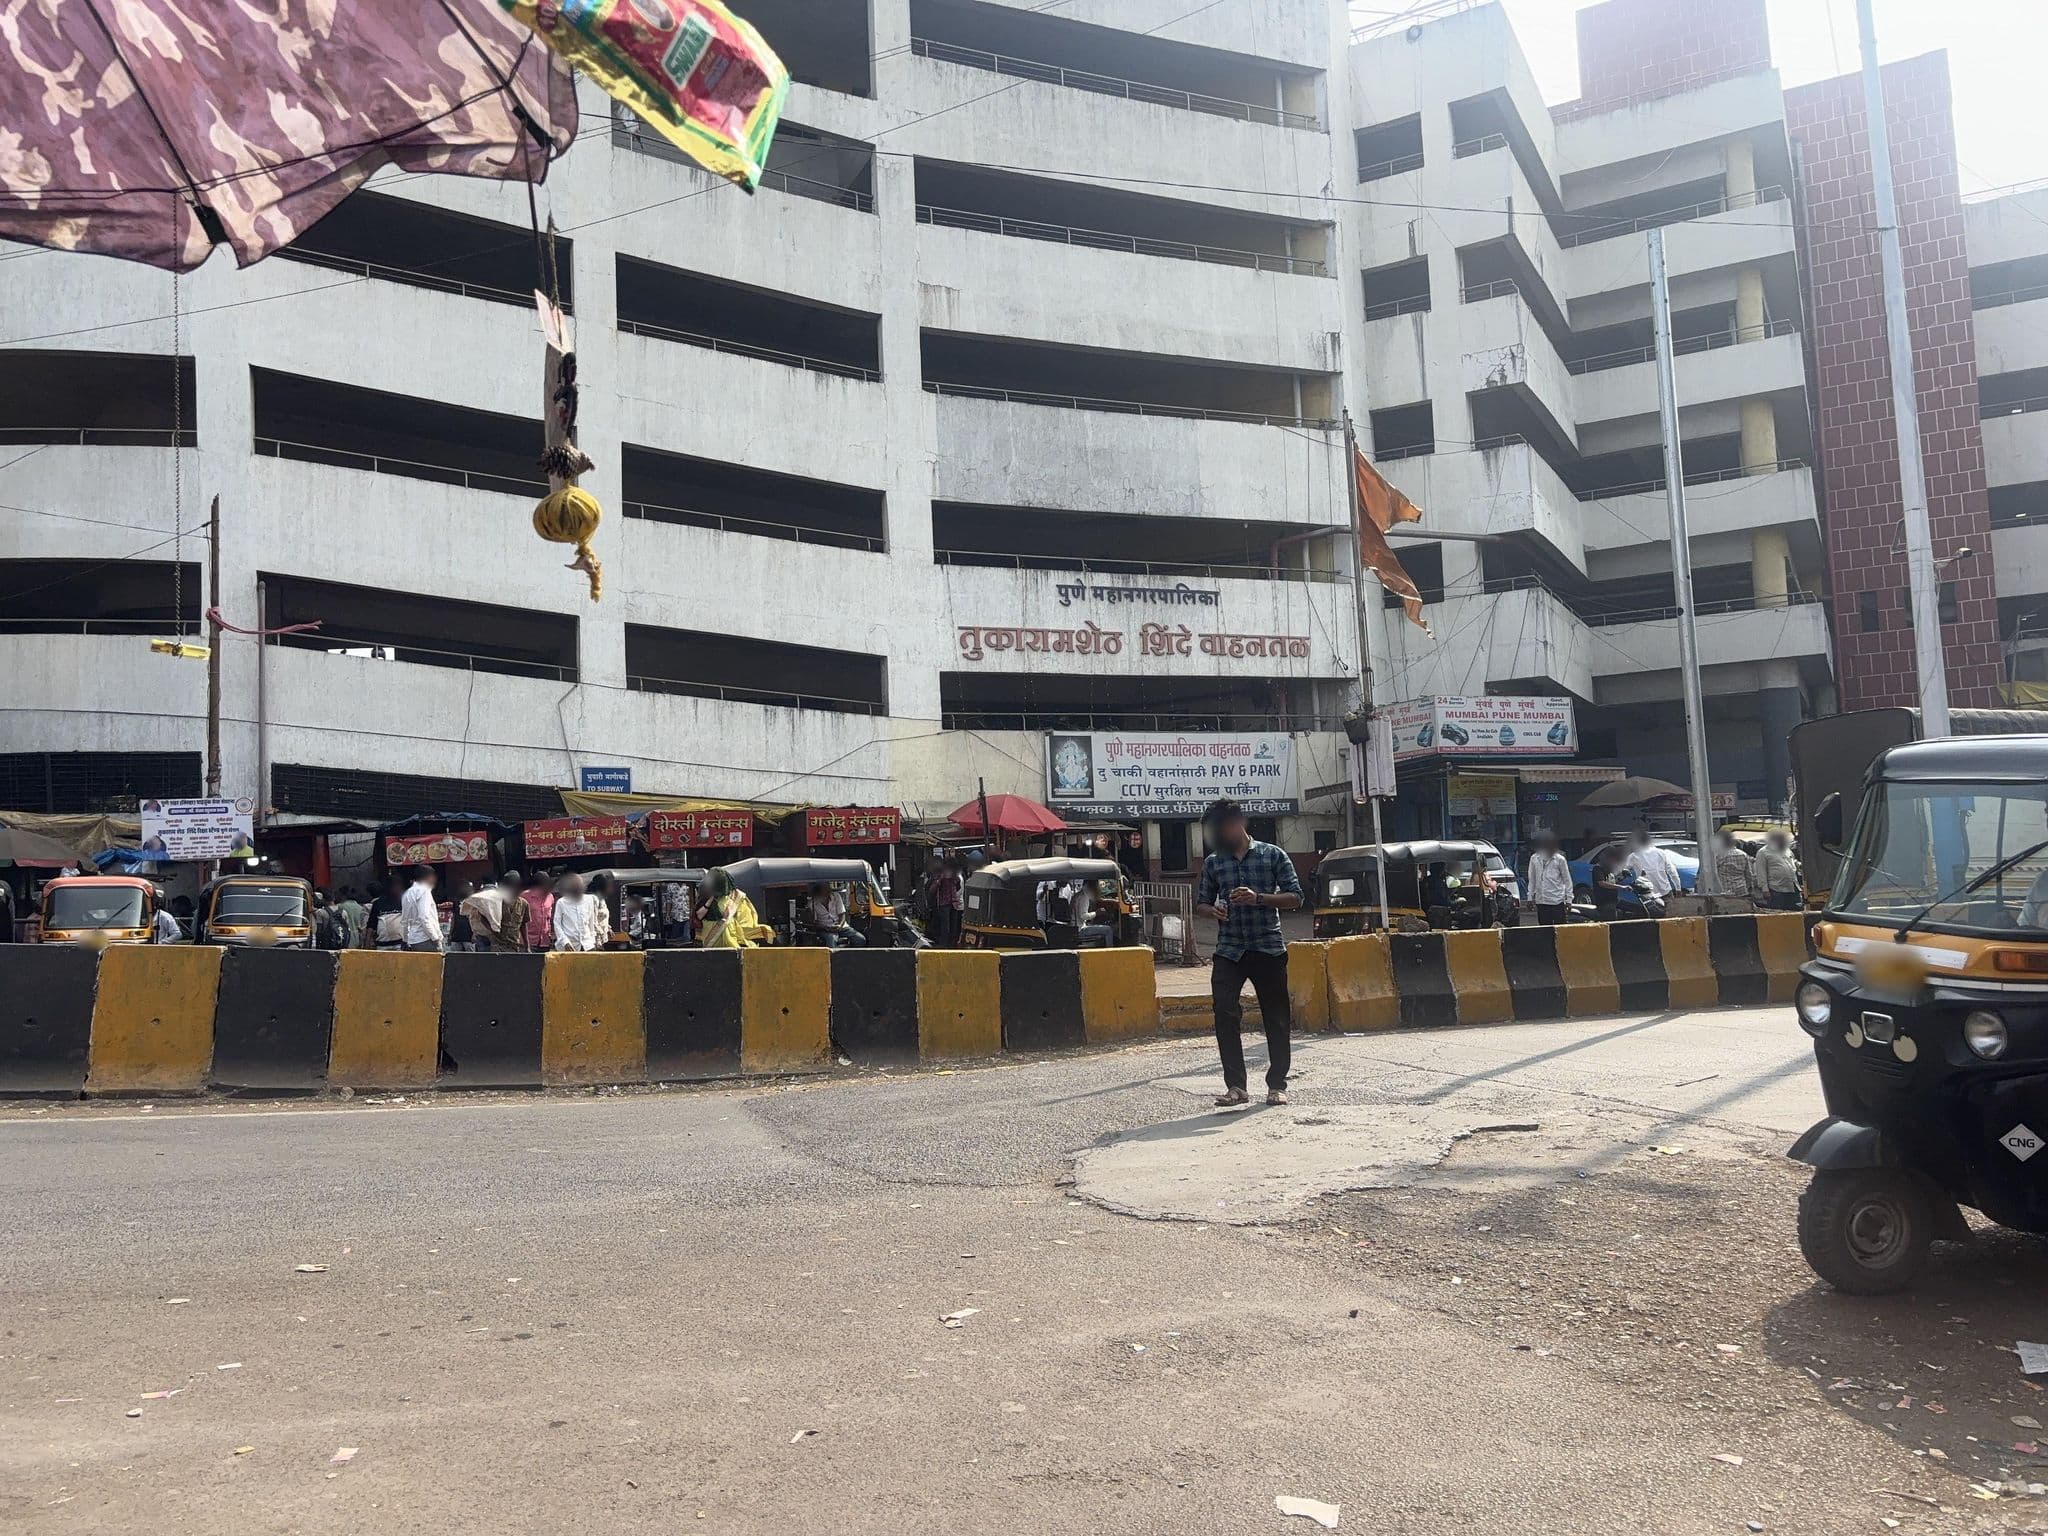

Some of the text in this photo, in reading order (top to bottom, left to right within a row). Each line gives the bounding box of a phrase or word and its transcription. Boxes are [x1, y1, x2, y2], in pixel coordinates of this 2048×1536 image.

[1056, 579, 1220, 607] पुणे महानगरपालिका
[958, 621, 1311, 660] तुकारामशेठ शिंदे वाहनतळ
[1445, 711, 1564, 720] MUMBAI PUNE MUMBAI
[1105, 737, 1251, 762] पुणे महानगरपालिका वाहनतळ
[1097, 768, 1107, 782] दु
[1111, 765, 1142, 777] चाकी
[1212, 765, 1234, 777] PAY
[1239, 765, 1246, 777] &
[1250, 764, 1281, 777] PARK
[1122, 784, 1151, 797] CCTV
[1154, 784, 1192, 800] सुरक्षित
[1197, 786, 1220, 796] भव्य
[654, 813, 696, 832] दोस्ती
[2009, 1137, 2035, 1148] CNG
